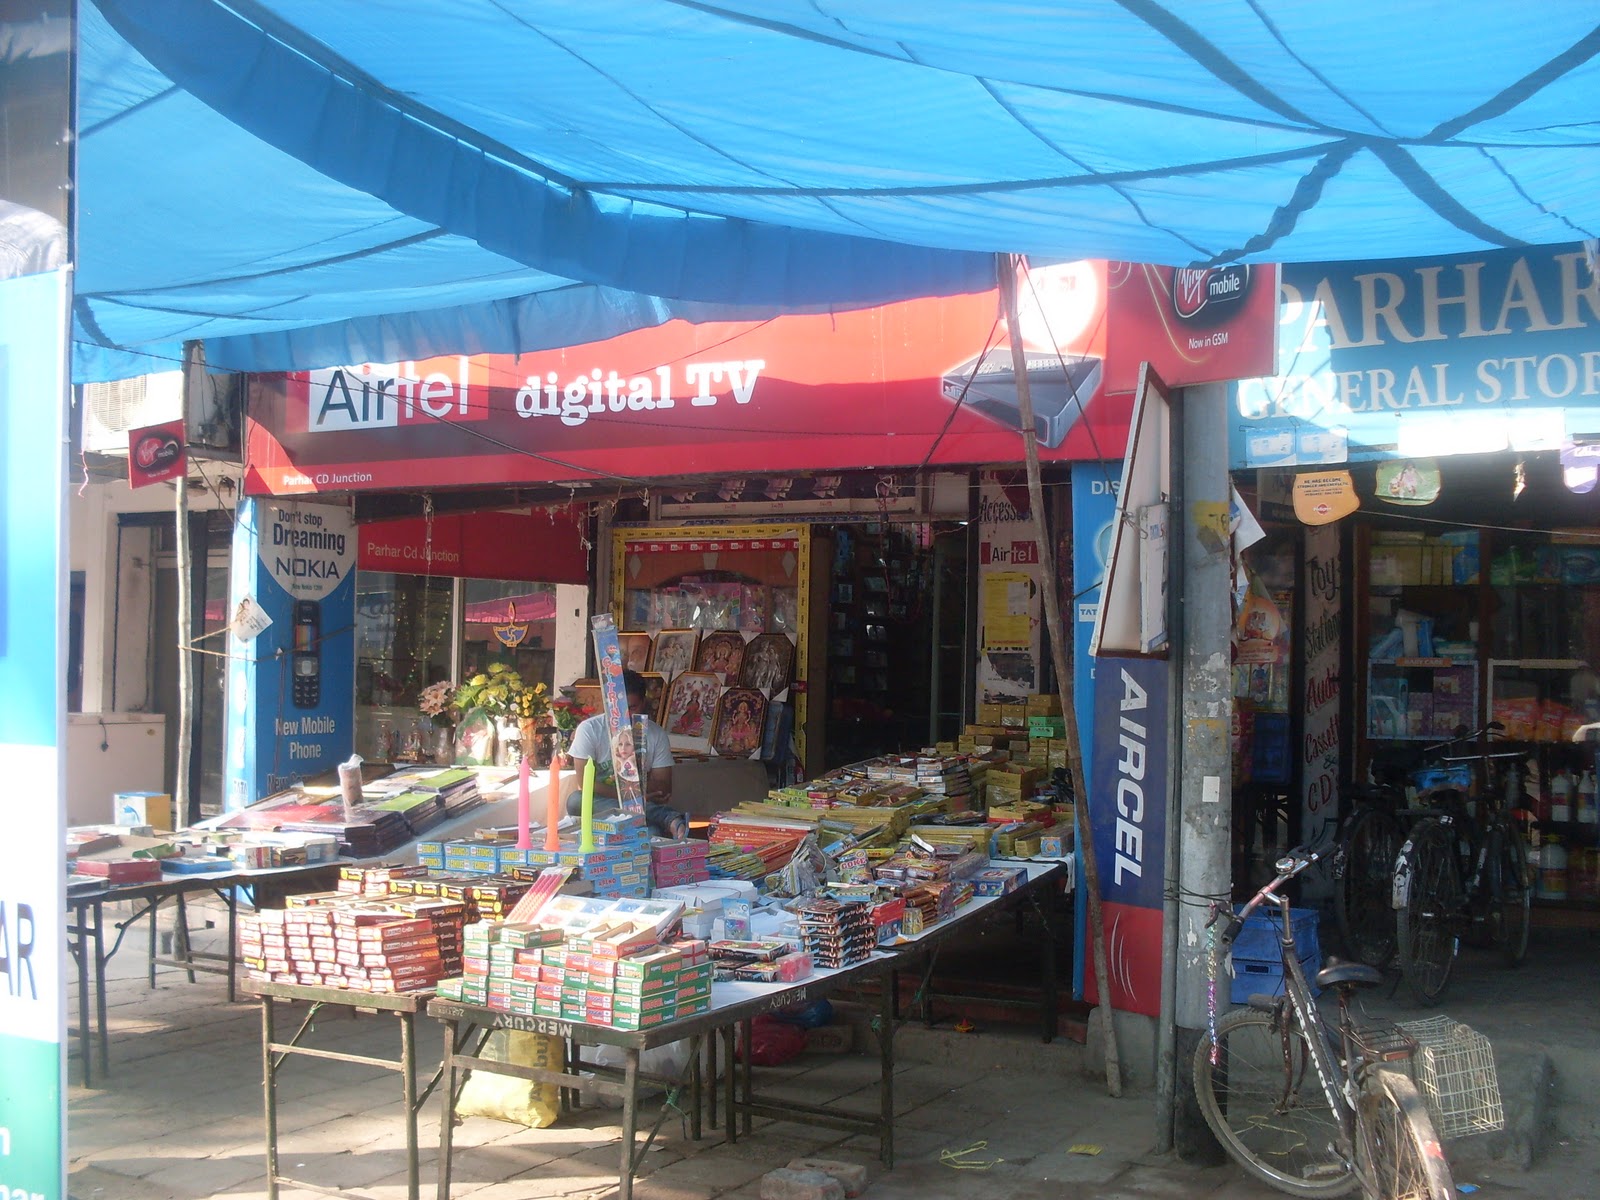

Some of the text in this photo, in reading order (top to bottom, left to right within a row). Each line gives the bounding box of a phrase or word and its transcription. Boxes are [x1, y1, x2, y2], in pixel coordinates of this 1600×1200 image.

[1209, 271, 1240, 296] mobile
[1188, 332, 1229, 350] Now in GSM
[315, 355, 470, 425] Airtel
[515, 359, 766, 427] digital TV
[1236, 363, 1465, 420] GENERAL
[282, 472, 373, 486] Parhar CD Junction
[1091, 481, 1121, 495] DIS
[278, 509, 323, 528] Don't stop
[273, 523, 345, 556] Dreaming
[367, 542, 459, 563] Parhar Cd Jnction
[991, 541, 1034, 563] Airtel
[276, 556, 340, 579] NOKIA
[275, 715, 336, 736] New Mobile
[289, 741, 322, 760] Phone
[1113, 667, 1148, 886] AIRCEL
[768, 986, 807, 1010] MECURY
[492, 1013, 573, 1038] MERCURY
